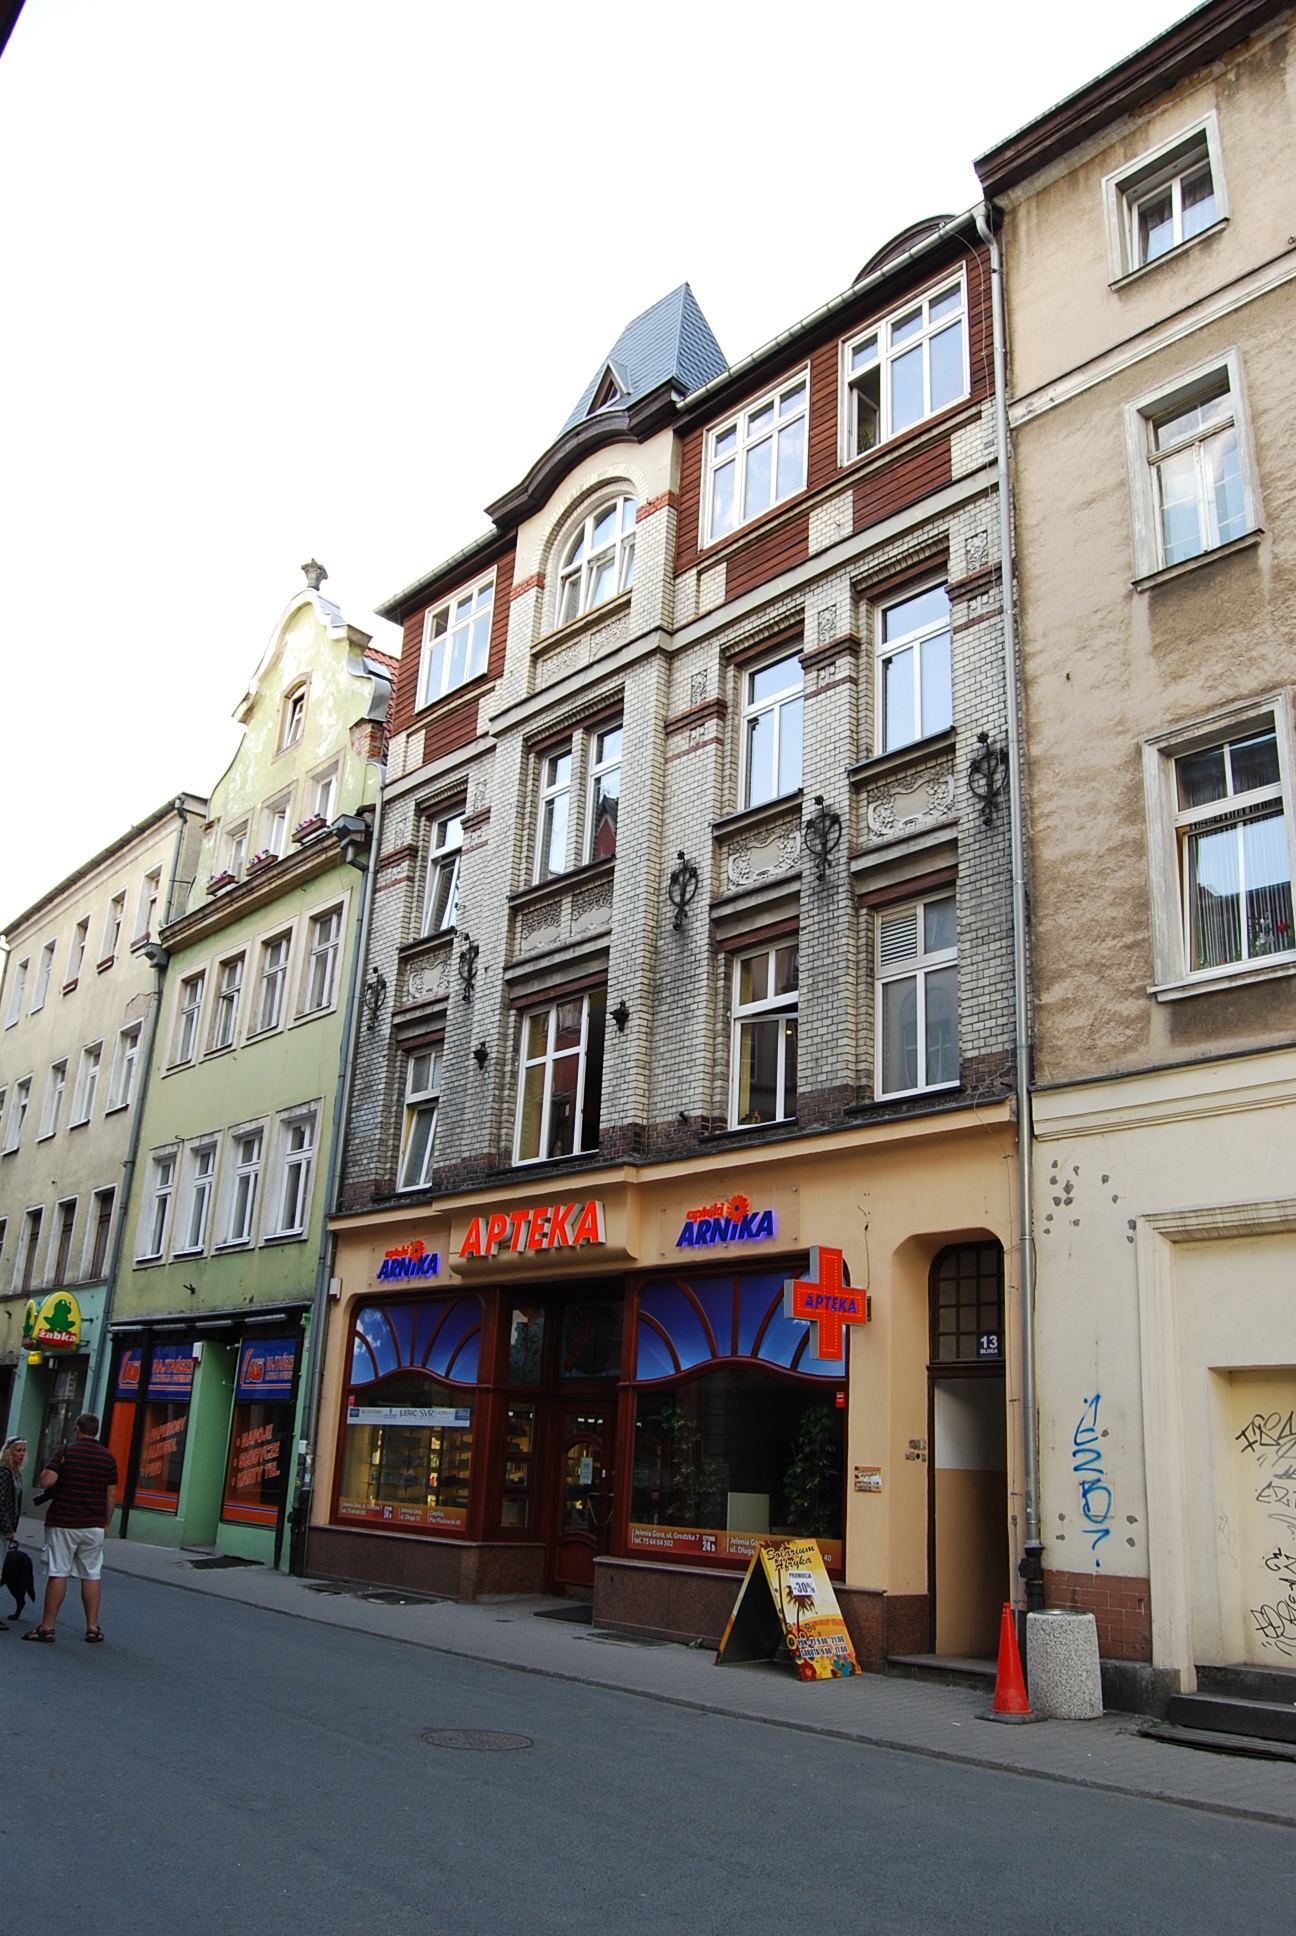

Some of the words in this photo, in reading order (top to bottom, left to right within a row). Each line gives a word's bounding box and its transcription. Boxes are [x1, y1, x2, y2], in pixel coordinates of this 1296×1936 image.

[459, 1199, 607, 1257] APTEKA
[804, 1293, 857, 1313] APTEKA
[39, 1328, 77, 1342] żabka
[980, 1335, 998, 1349] 13
[702, 1541, 711, 1552] 24
[730, 1537, 750, 1545] Jelenia
[766, 1545, 816, 1560] Solarium
[824, 1554, 832, 1562] 40
[775, 1555, 813, 1571] Afryka
[793, 1581, 816, 1593] -30%
